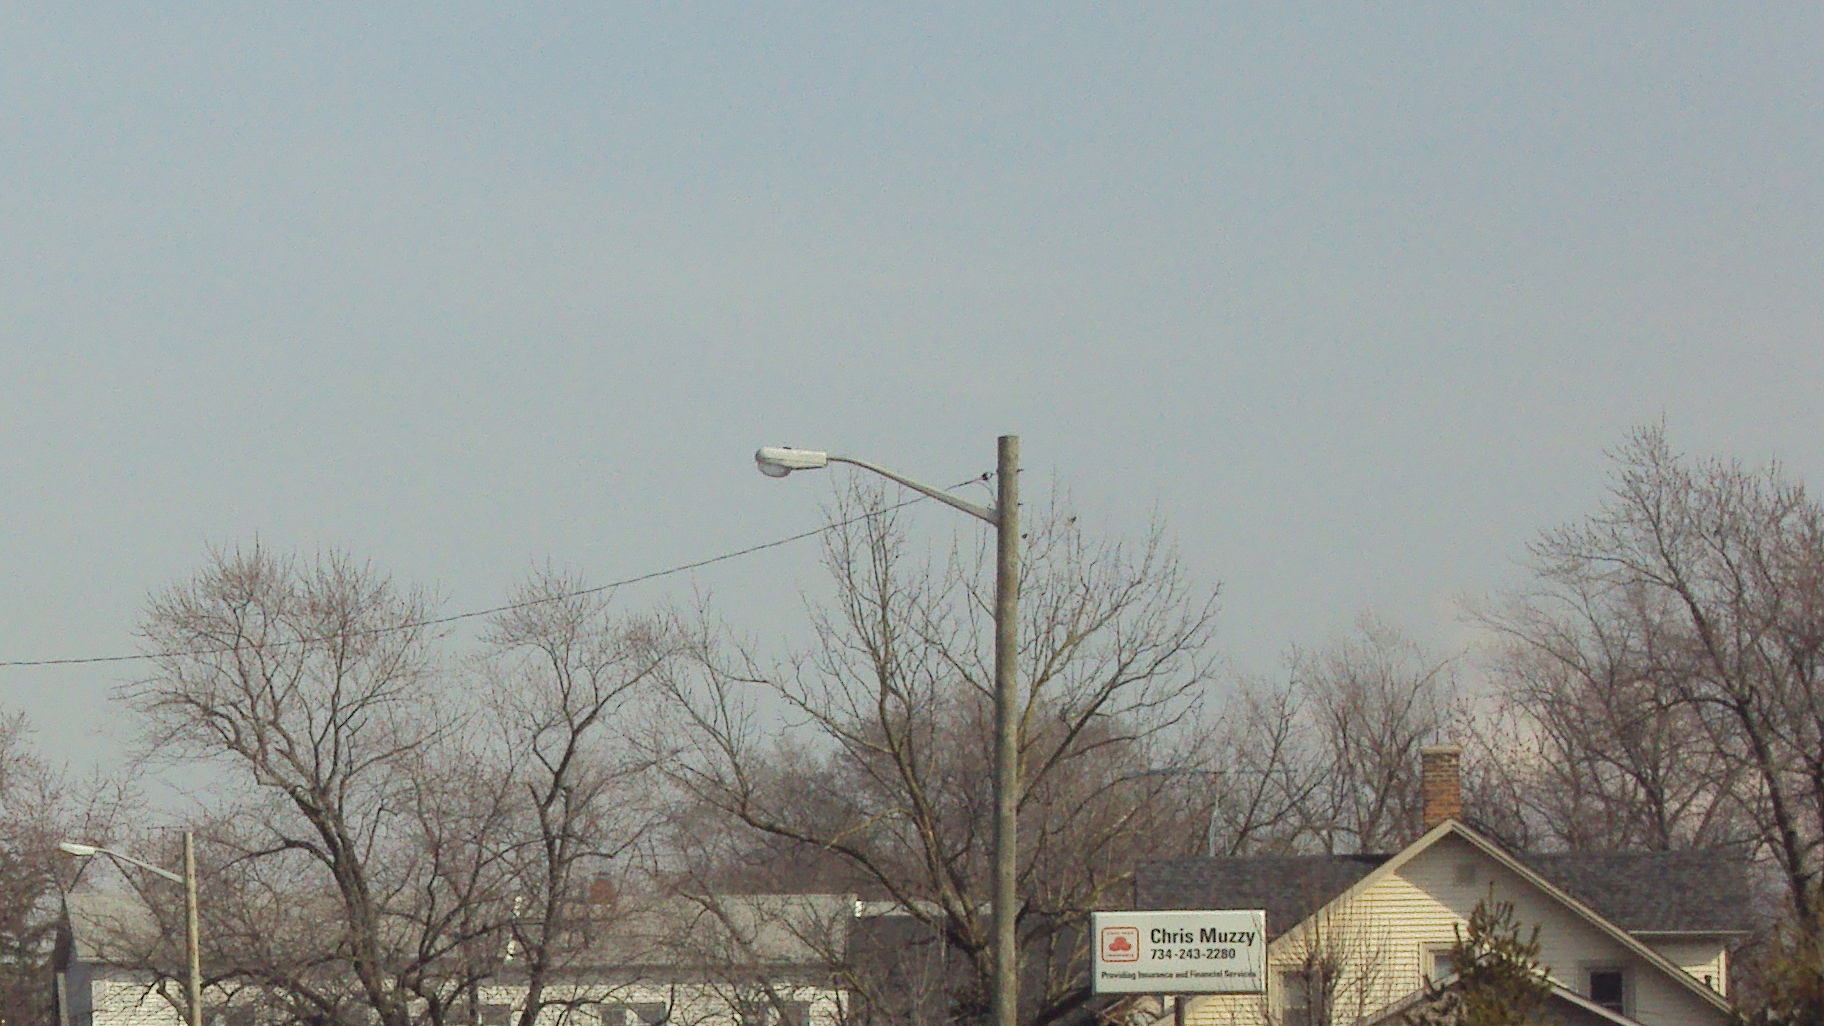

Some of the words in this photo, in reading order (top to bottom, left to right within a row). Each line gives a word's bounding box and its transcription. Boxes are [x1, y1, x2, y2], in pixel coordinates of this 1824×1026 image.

[1150, 927, 1194, 944] Chris
[1199, 927, 1256, 947] Muzzy
[1151, 948, 1236, 960] 734-243-2280
